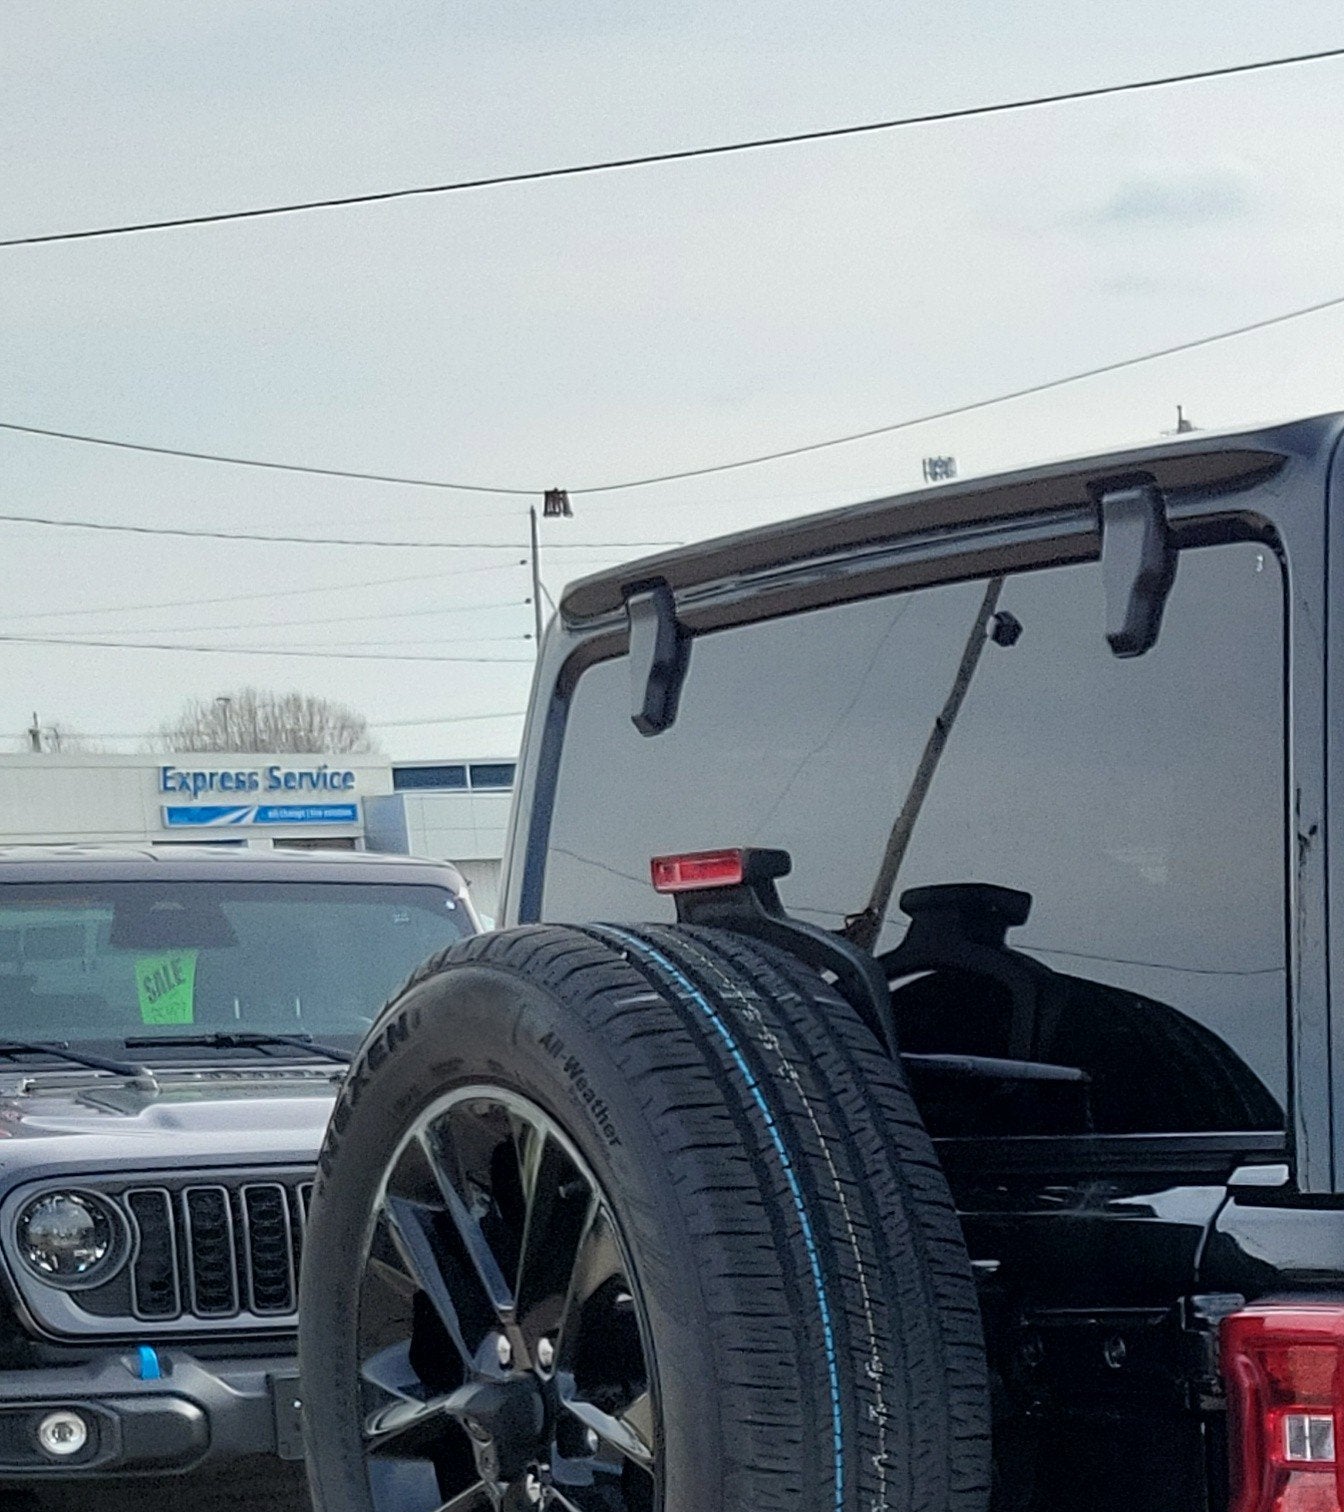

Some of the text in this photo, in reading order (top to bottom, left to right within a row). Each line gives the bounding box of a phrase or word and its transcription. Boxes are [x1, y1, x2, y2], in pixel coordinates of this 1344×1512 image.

[161, 764, 356, 799] Express Service
[143, 957, 186, 1004] SALE
[539, 1031, 621, 1146] All-Weather
